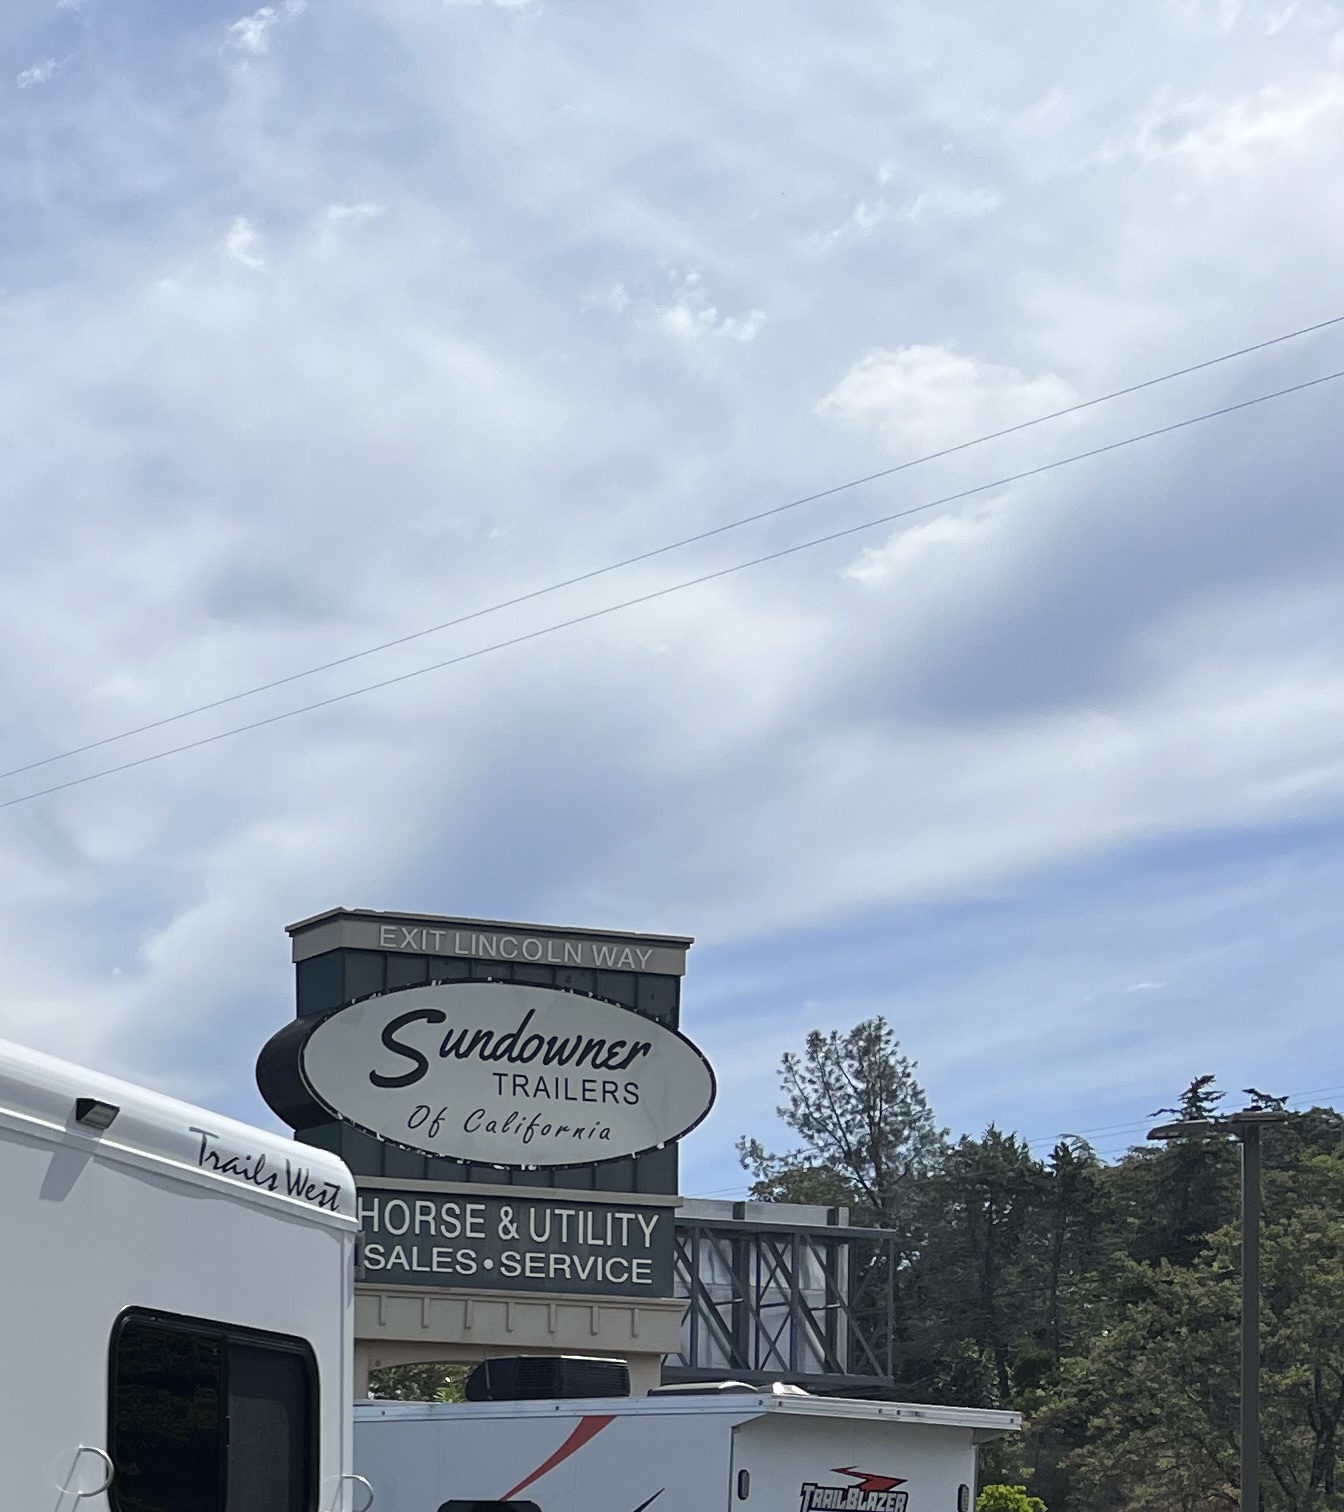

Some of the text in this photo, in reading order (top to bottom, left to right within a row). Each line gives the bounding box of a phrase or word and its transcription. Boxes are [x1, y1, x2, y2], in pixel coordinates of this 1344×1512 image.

[380, 925, 653, 969] EXIT LINCOLN WAY
[369, 1009, 652, 1088] Sundowner
[492, 1073, 639, 1105] TRAILERS
[407, 1105, 611, 1143] Of California
[189, 1126, 341, 1212] Trails West
[358, 1196, 659, 1248] HORSE & UTILITY
[363, 1244, 652, 1284] SALES SERVICE
